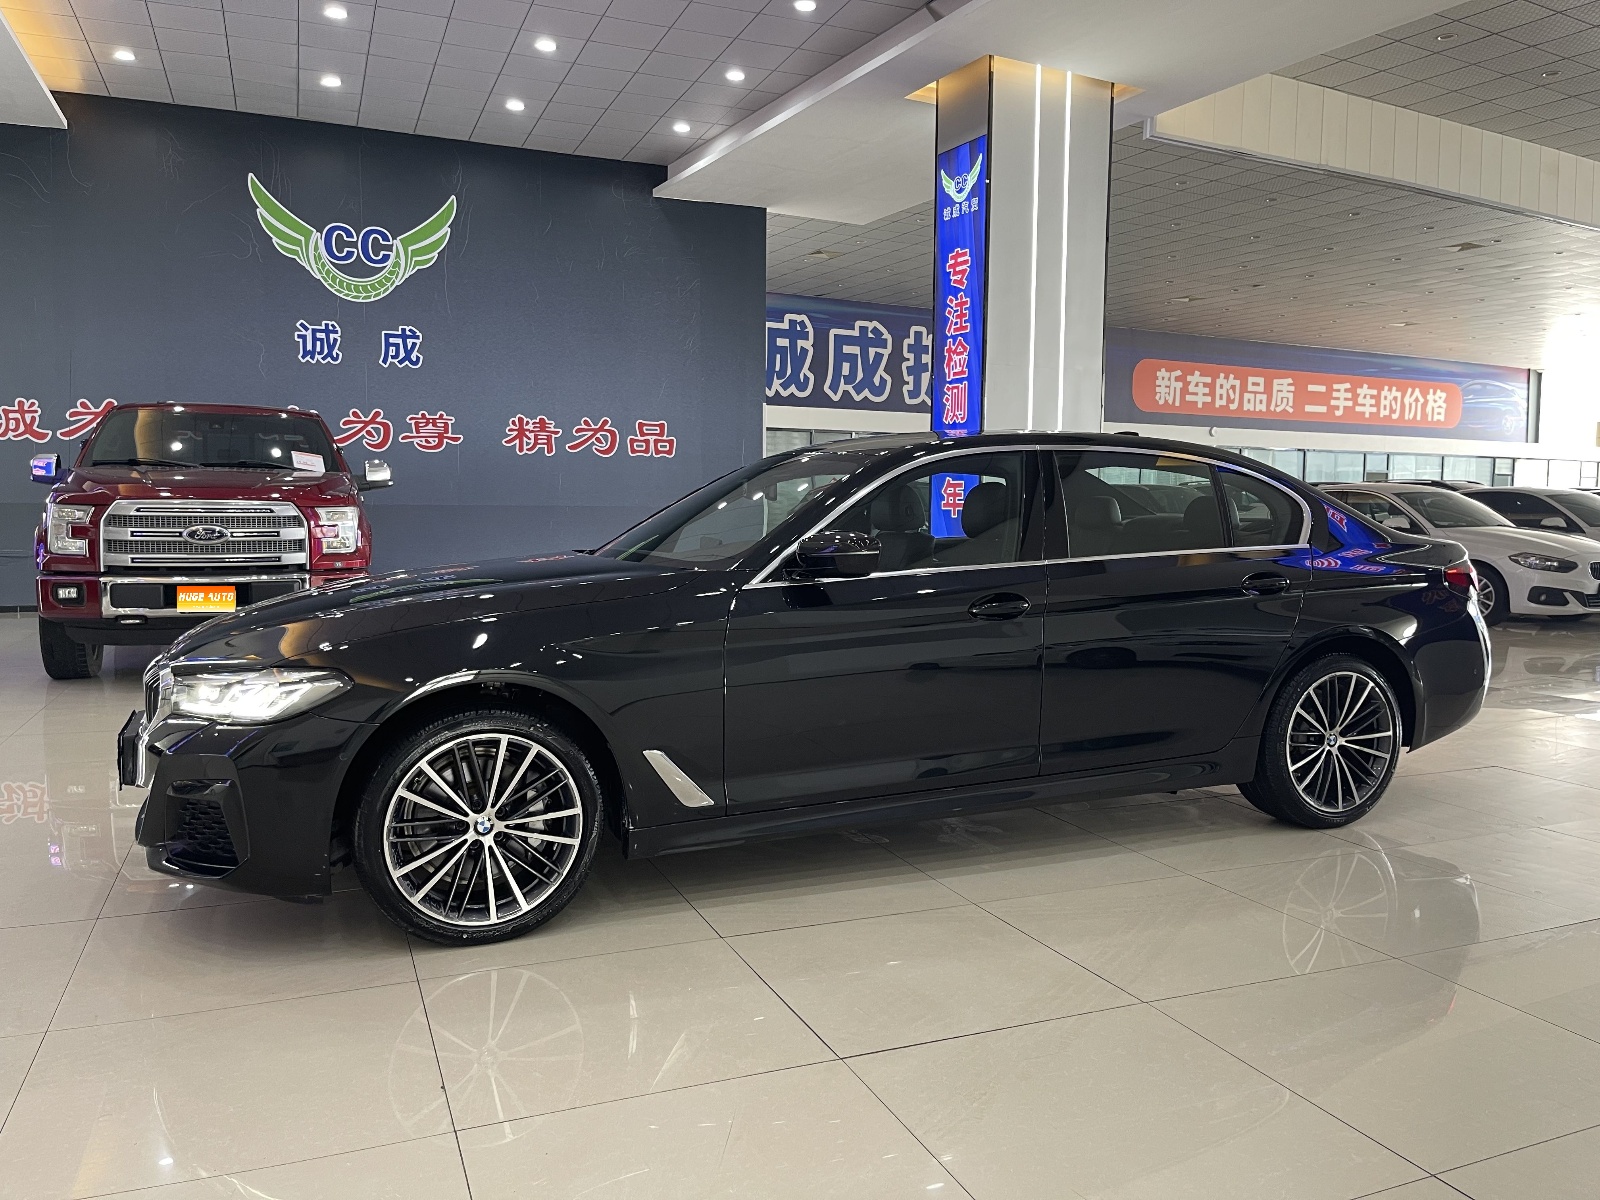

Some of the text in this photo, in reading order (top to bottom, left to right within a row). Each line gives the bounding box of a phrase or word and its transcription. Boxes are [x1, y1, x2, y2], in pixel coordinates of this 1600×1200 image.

[322, 222, 393, 267] CC
[1155, 368, 1447, 422] 新车的品质 二手车的价格
[194, 527, 221, 540] Ford
